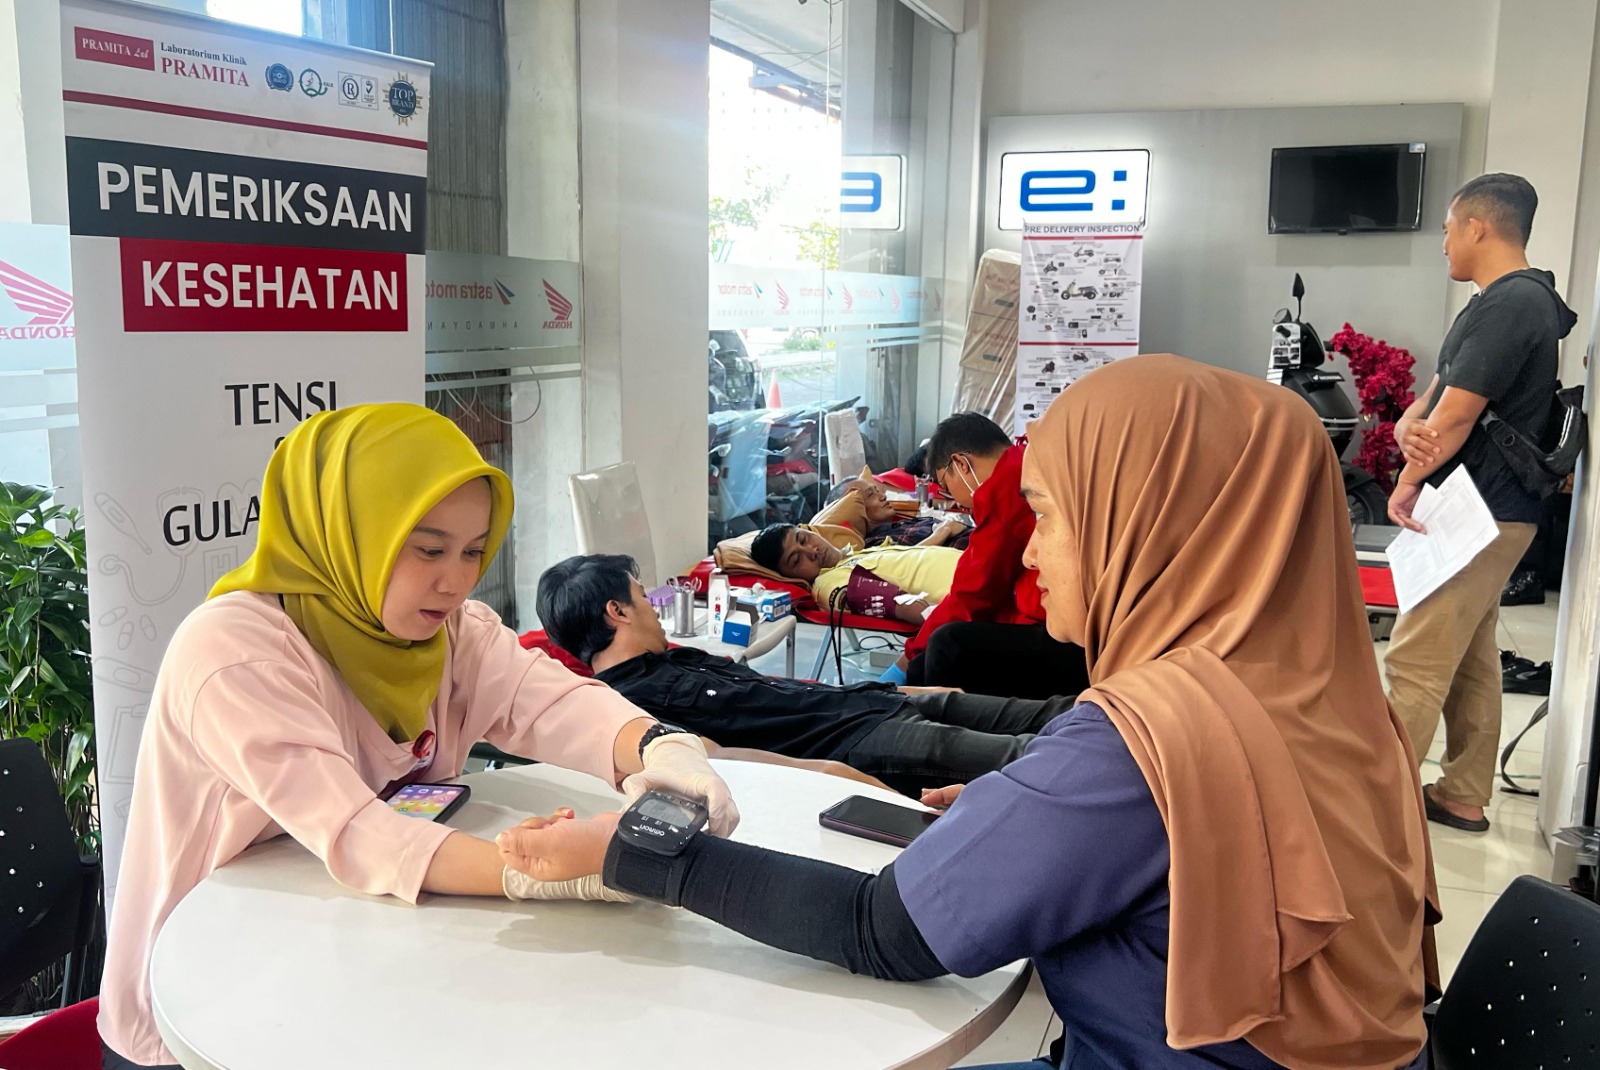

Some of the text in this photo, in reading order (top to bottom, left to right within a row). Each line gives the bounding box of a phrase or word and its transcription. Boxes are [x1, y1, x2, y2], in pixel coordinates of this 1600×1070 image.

[82, 37, 131, 57] PRAMITA
[160, 42, 248, 66] Laboratorium Klinik
[161, 57, 250, 87] PRAMITA
[391, 98, 415, 109] BRAND
[392, 87, 414, 101] TOP
[97, 161, 412, 233] PEMERIKSAAN
[1025, 224, 1140, 234] PRE DELIVERY INSPECTION
[142, 260, 399, 312] KESEHATAN
[224, 380, 337, 426] TENSI
[162, 495, 261, 547] GULA
